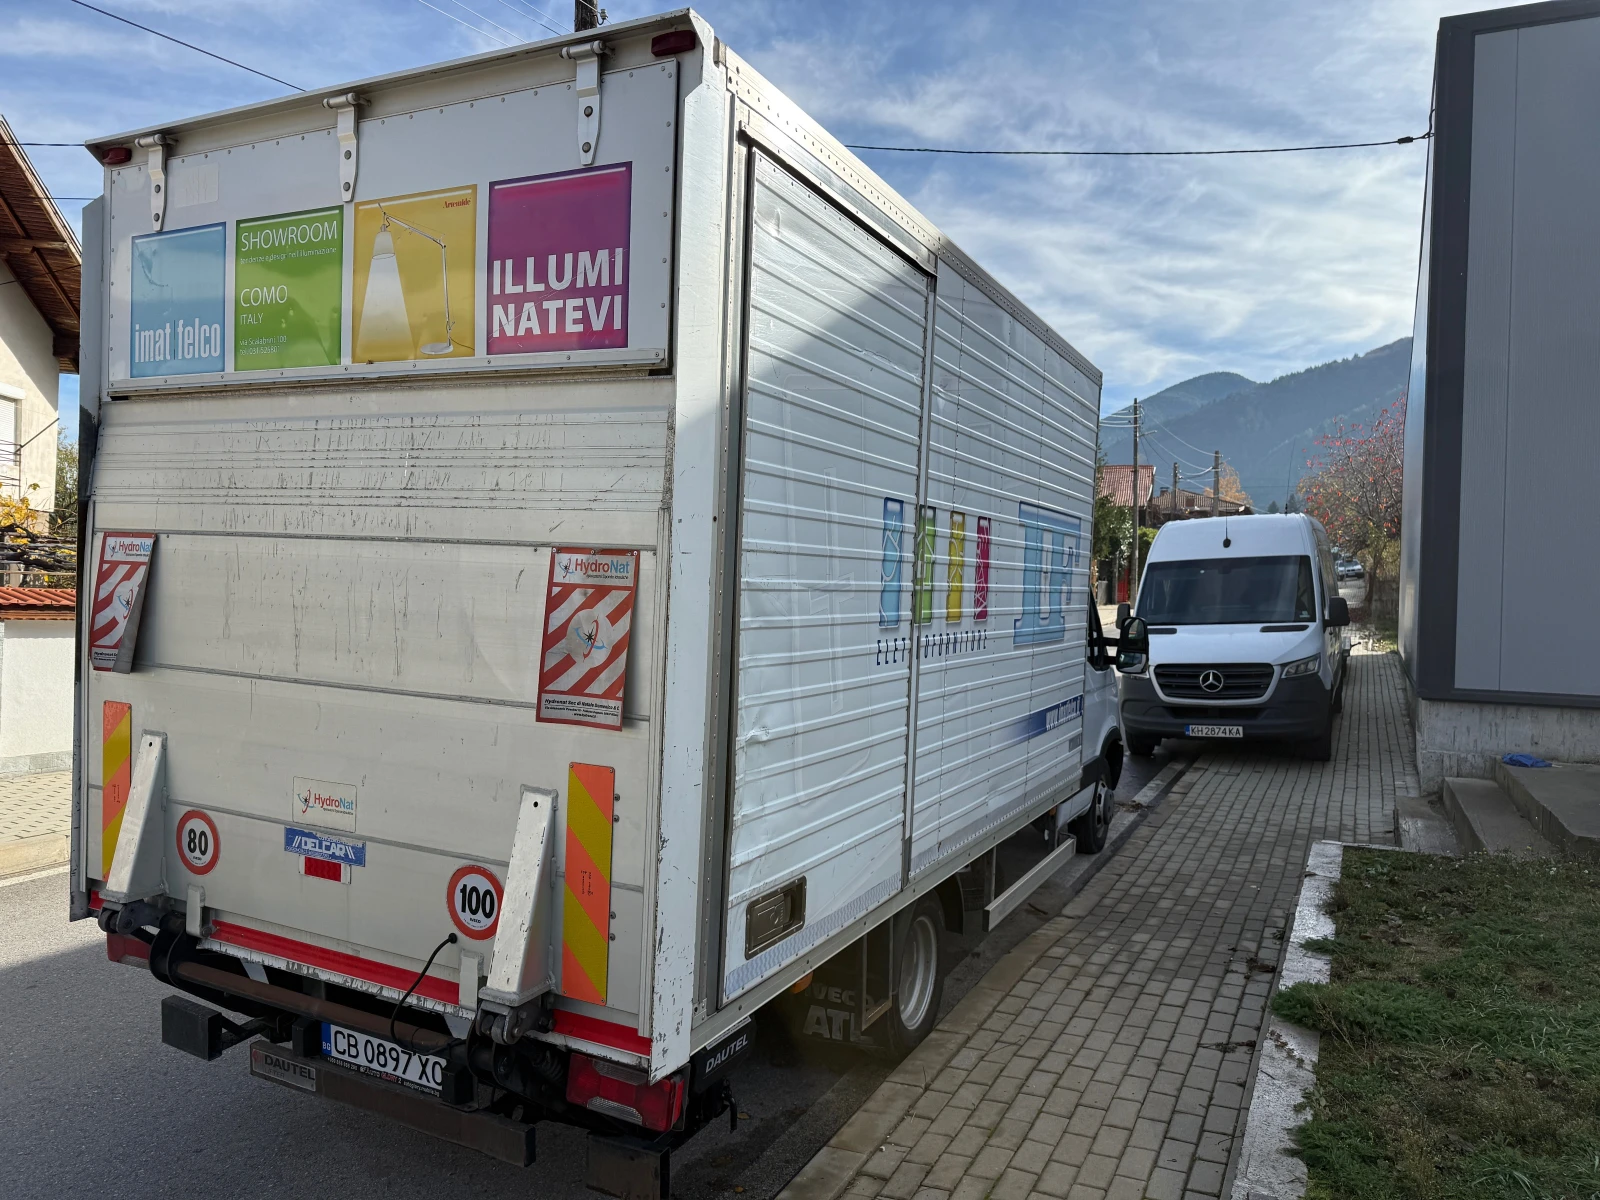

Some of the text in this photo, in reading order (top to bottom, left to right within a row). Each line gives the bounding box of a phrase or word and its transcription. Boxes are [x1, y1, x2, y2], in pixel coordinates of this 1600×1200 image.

[241, 220, 338, 252] SHOWROOM
[493, 247, 623, 295] ILLUMI
[240, 285, 287, 307] COMO
[240, 312, 264, 325] ITALY
[493, 295, 622, 338] NATEVI
[135, 317, 220, 363] imat felco
[574, 558, 630, 576] HydroNat
[314, 793, 354, 811] HydroNat
[187, 828, 209, 856] 80
[301, 837, 346, 858] DELCAR
[460, 883, 495, 919] 100
[264, 1054, 316, 1080] DAUTEL
[322, 1042, 331, 1050] BG
[334, 1030, 360, 1059] CB
[364, 1039, 415, 1076] 0897
[706, 1033, 748, 1073] DAUTEL
